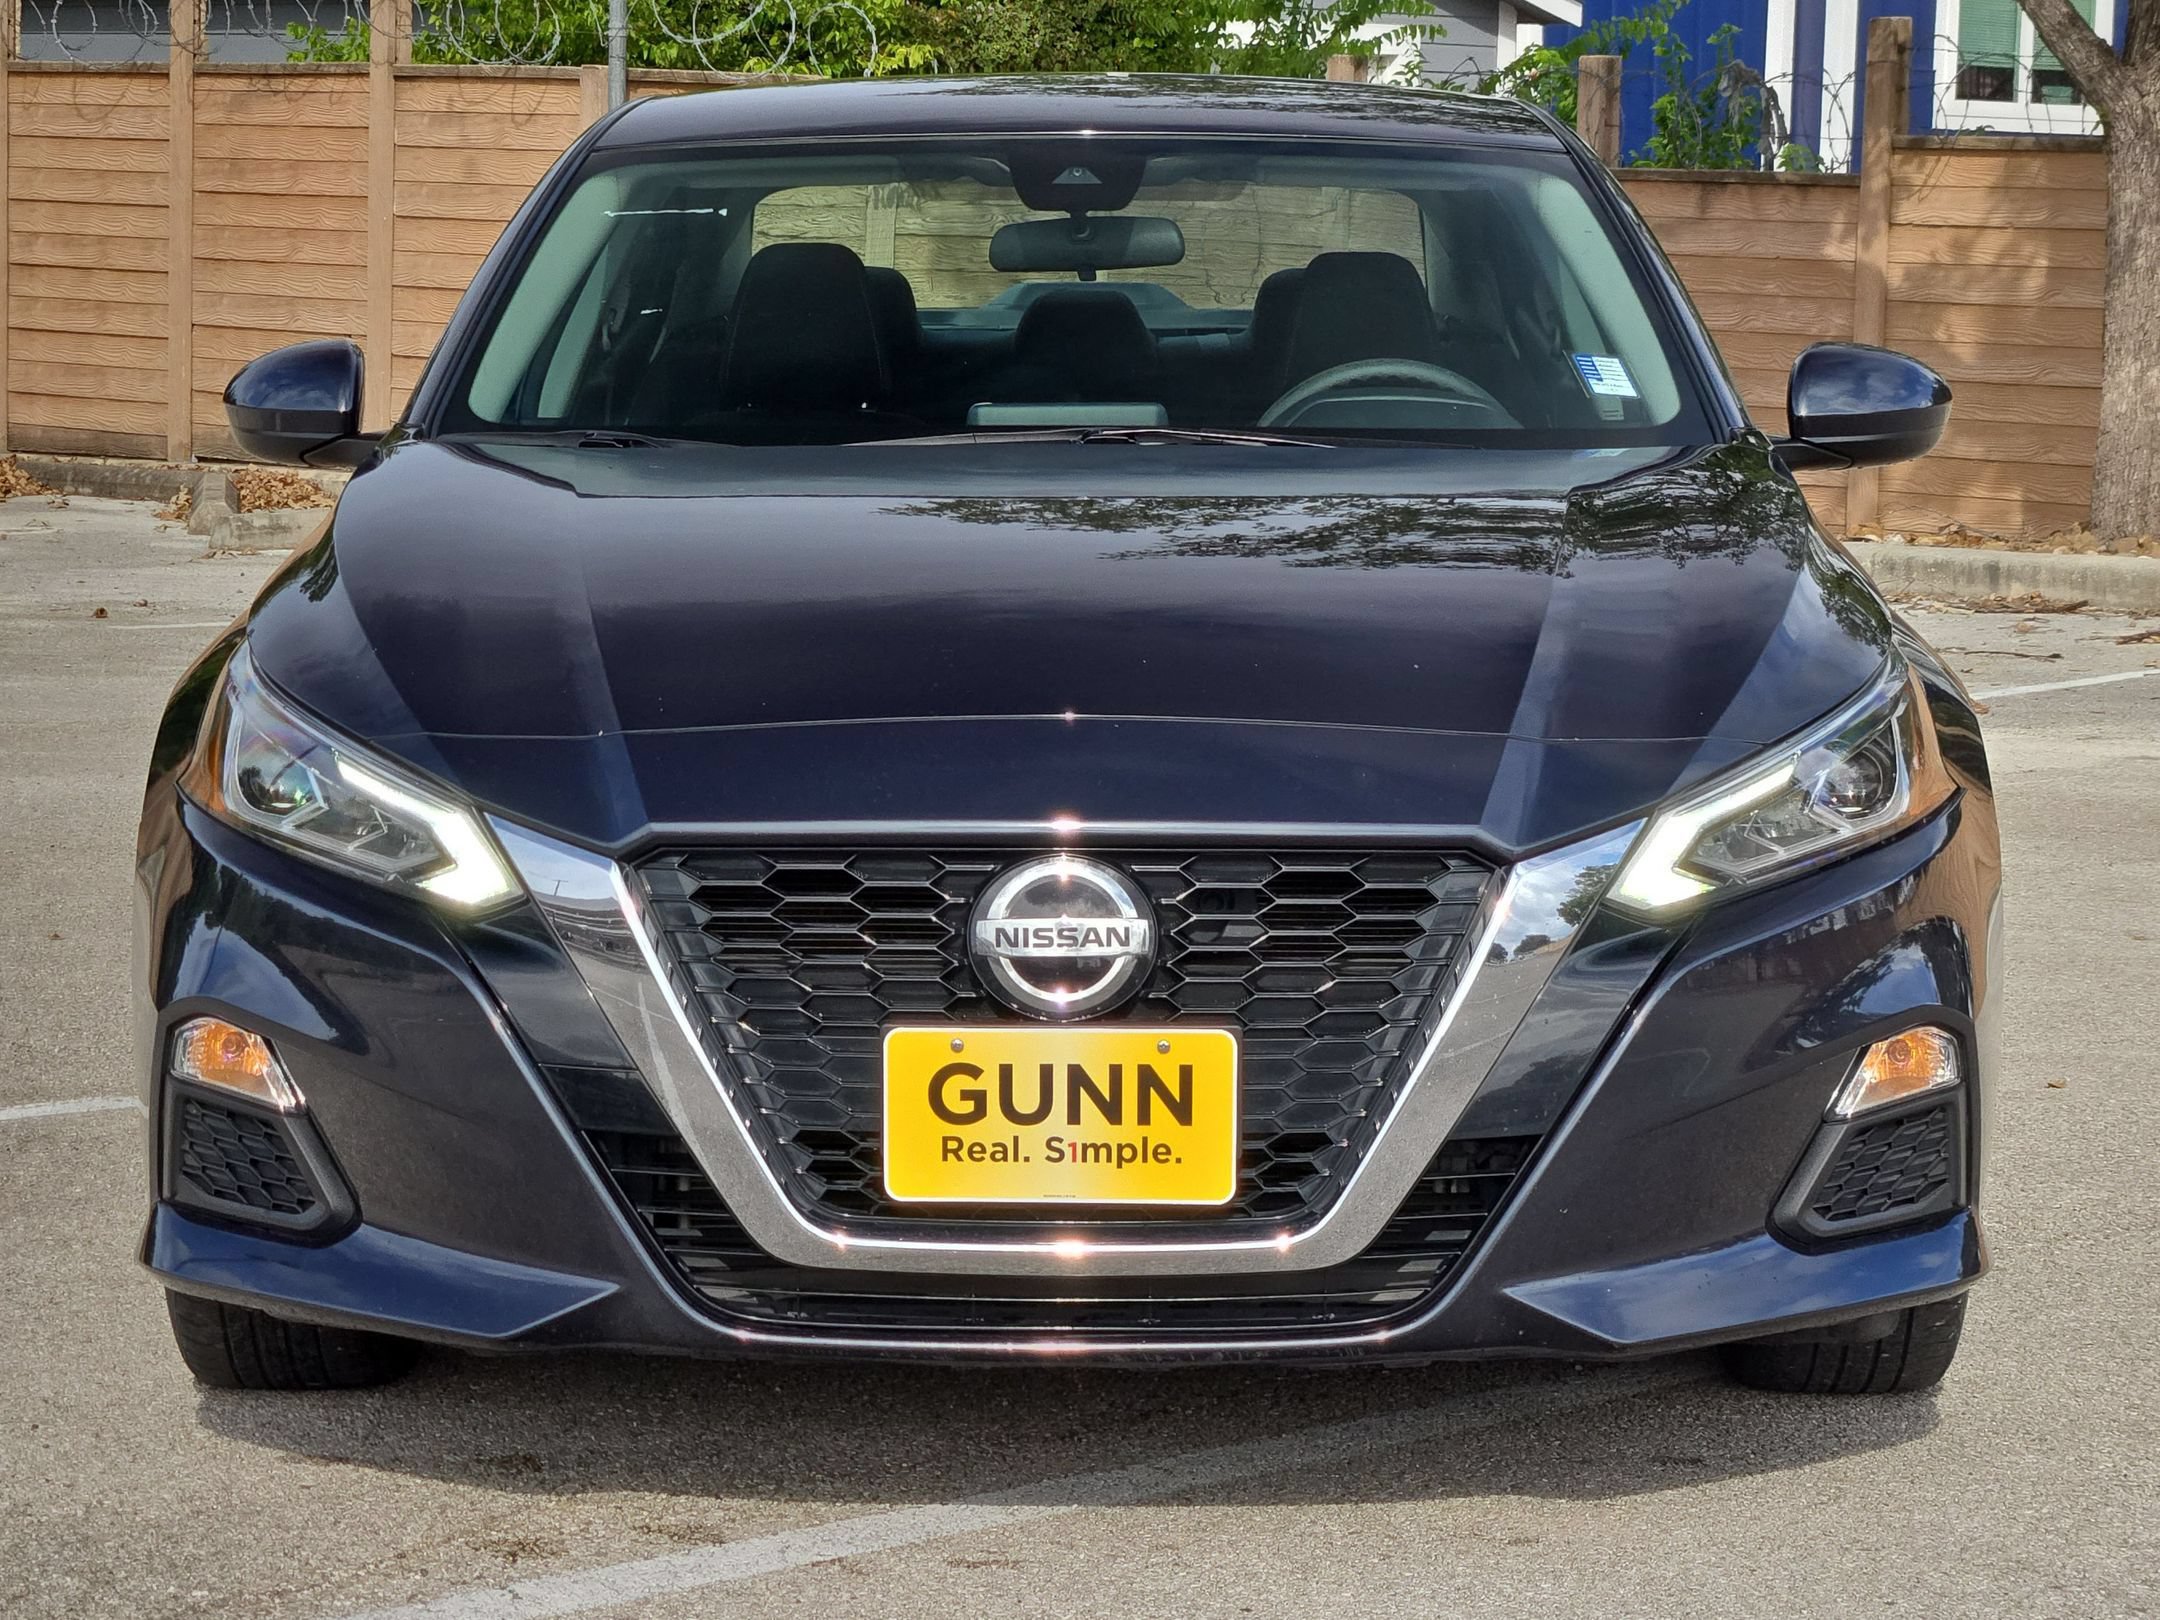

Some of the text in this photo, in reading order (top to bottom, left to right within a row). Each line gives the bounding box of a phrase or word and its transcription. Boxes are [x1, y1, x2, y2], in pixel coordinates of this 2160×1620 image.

[995, 927, 1130, 949] NISSAN
[928, 1062, 1193, 1127] GUNN
[941, 1136, 1182, 1169] Real. S1mple.
